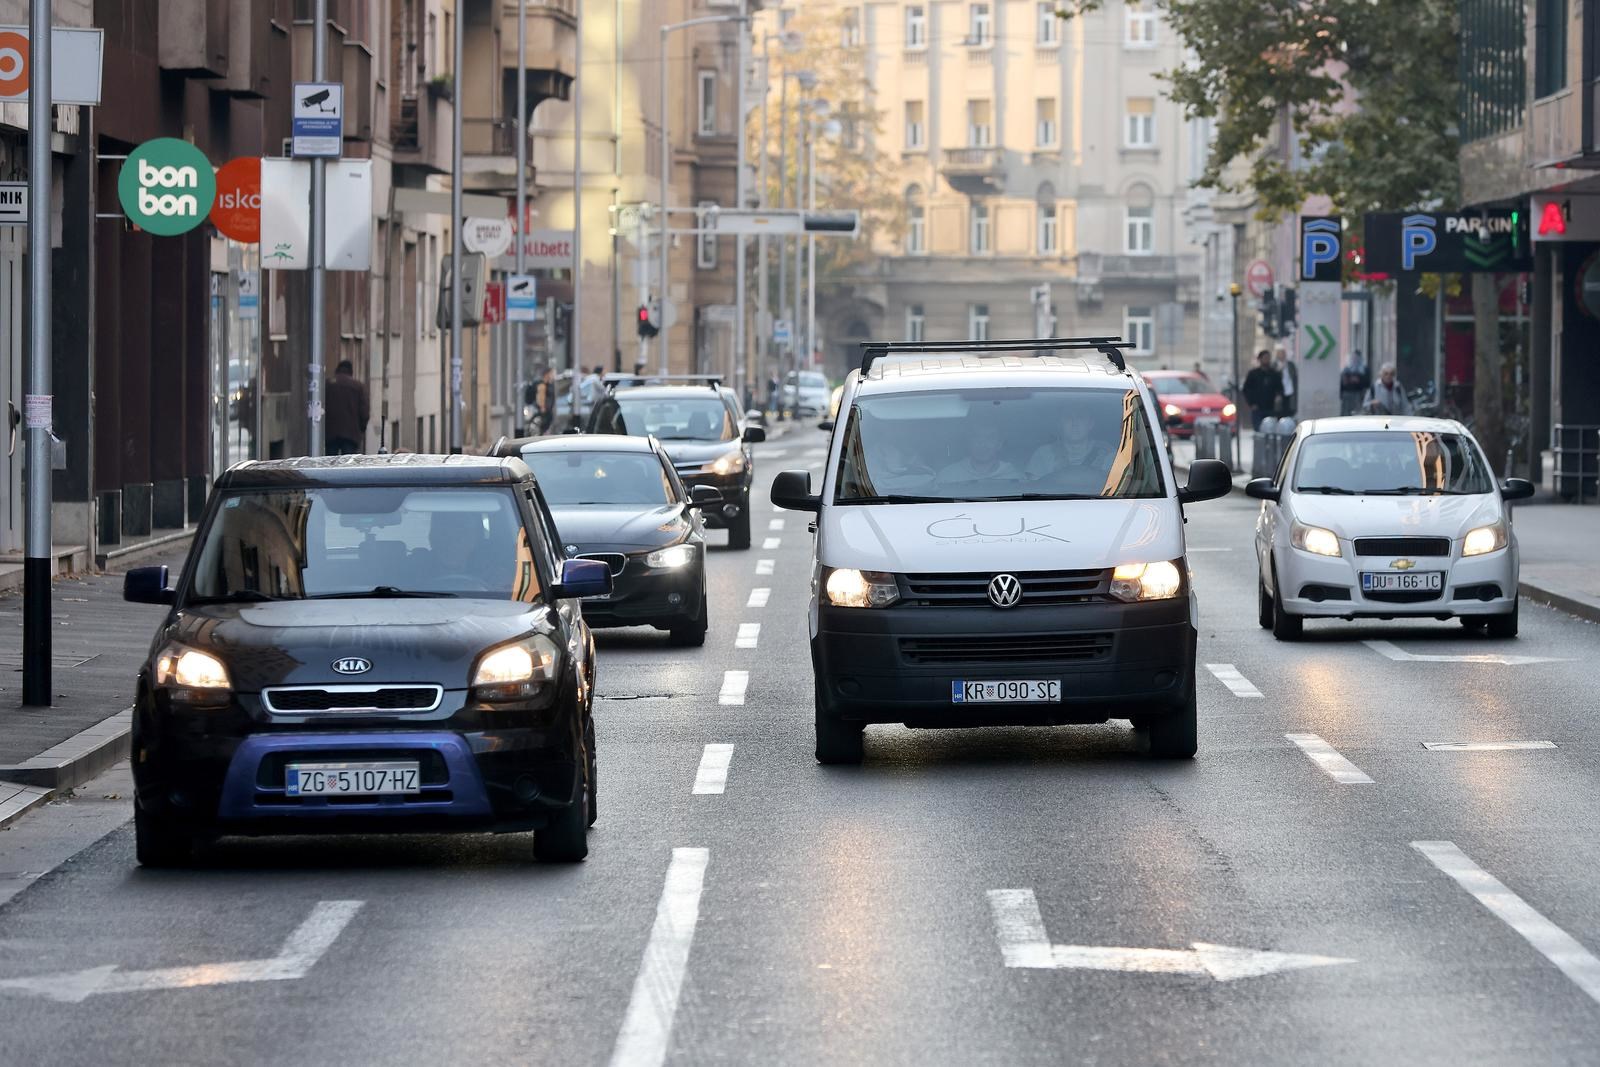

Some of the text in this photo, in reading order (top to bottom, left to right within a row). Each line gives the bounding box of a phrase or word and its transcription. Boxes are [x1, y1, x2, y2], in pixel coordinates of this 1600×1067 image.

[139, 159, 197, 188] bon
[139, 187, 197, 216] bon
[1446, 216, 1526, 233] PARKIN
[339, 660, 366, 671] KIA
[965, 683, 985, 700] KR
[998, 682, 1057, 699] 090-SC
[301, 772, 325, 792] ZG
[339, 770, 417, 791] 5107-HZ
